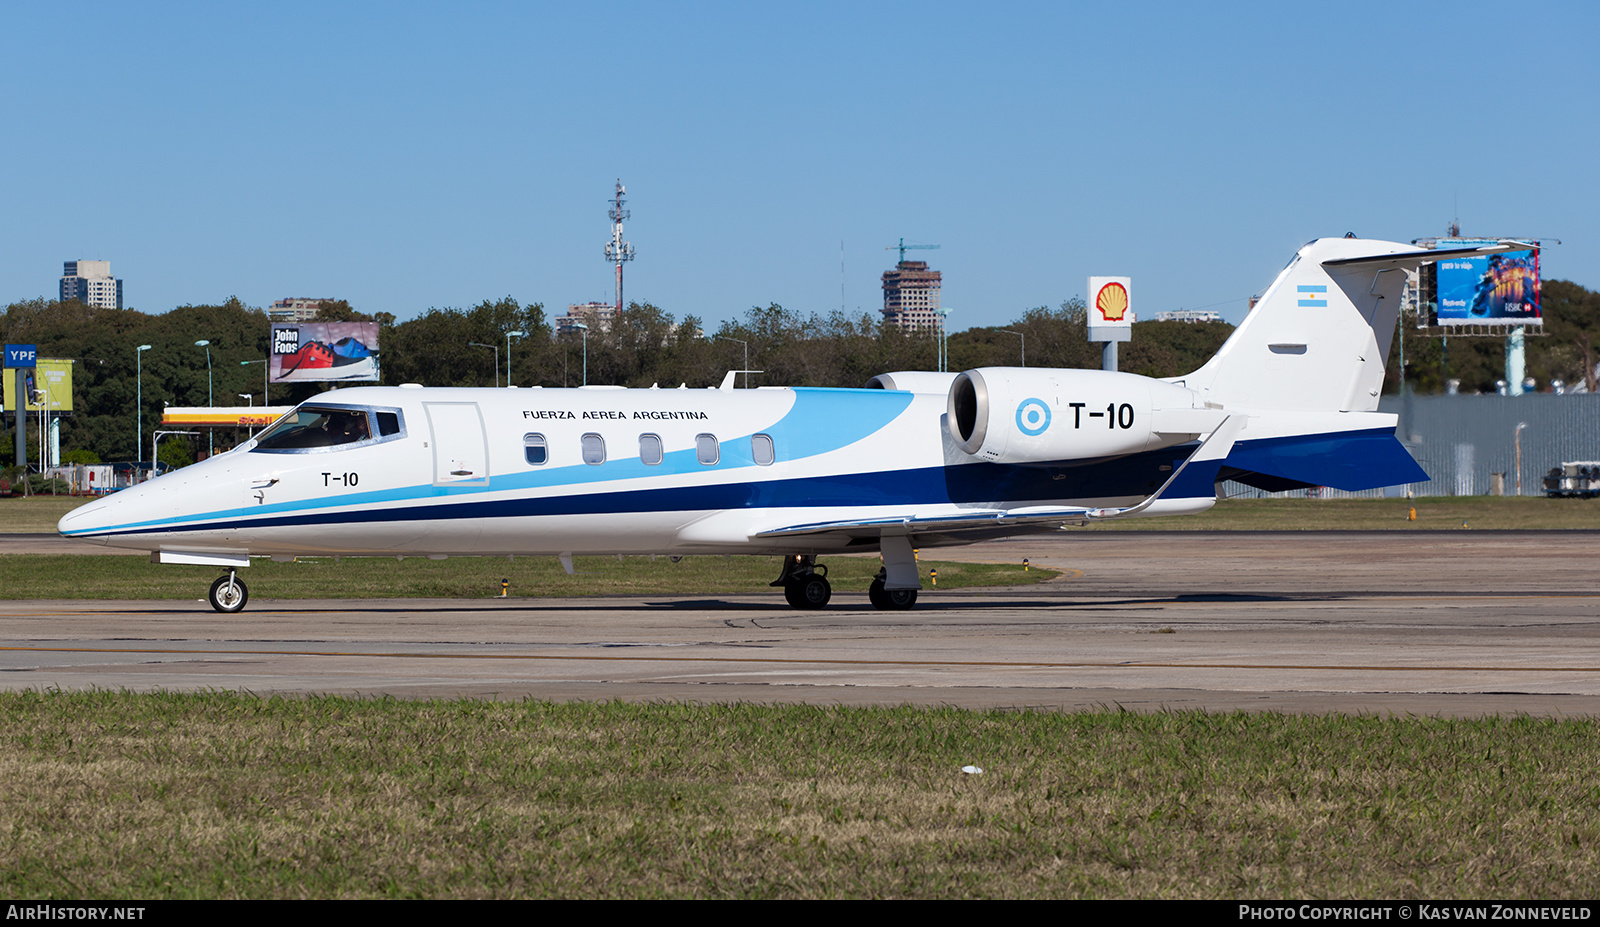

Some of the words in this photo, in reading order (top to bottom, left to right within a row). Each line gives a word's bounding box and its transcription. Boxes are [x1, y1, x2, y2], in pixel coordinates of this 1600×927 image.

[274, 329, 298, 342] John
[274, 341, 298, 354] Foos
[10, 350, 36, 361] YPF
[239, 416, 273, 425] Shell
[522, 410, 576, 420] FUERZA
[582, 410, 627, 420] AEREA
[633, 410, 709, 420] ARGENTINA
[1068, 402, 1135, 430] T-10
[321, 472, 359, 487] T-10
